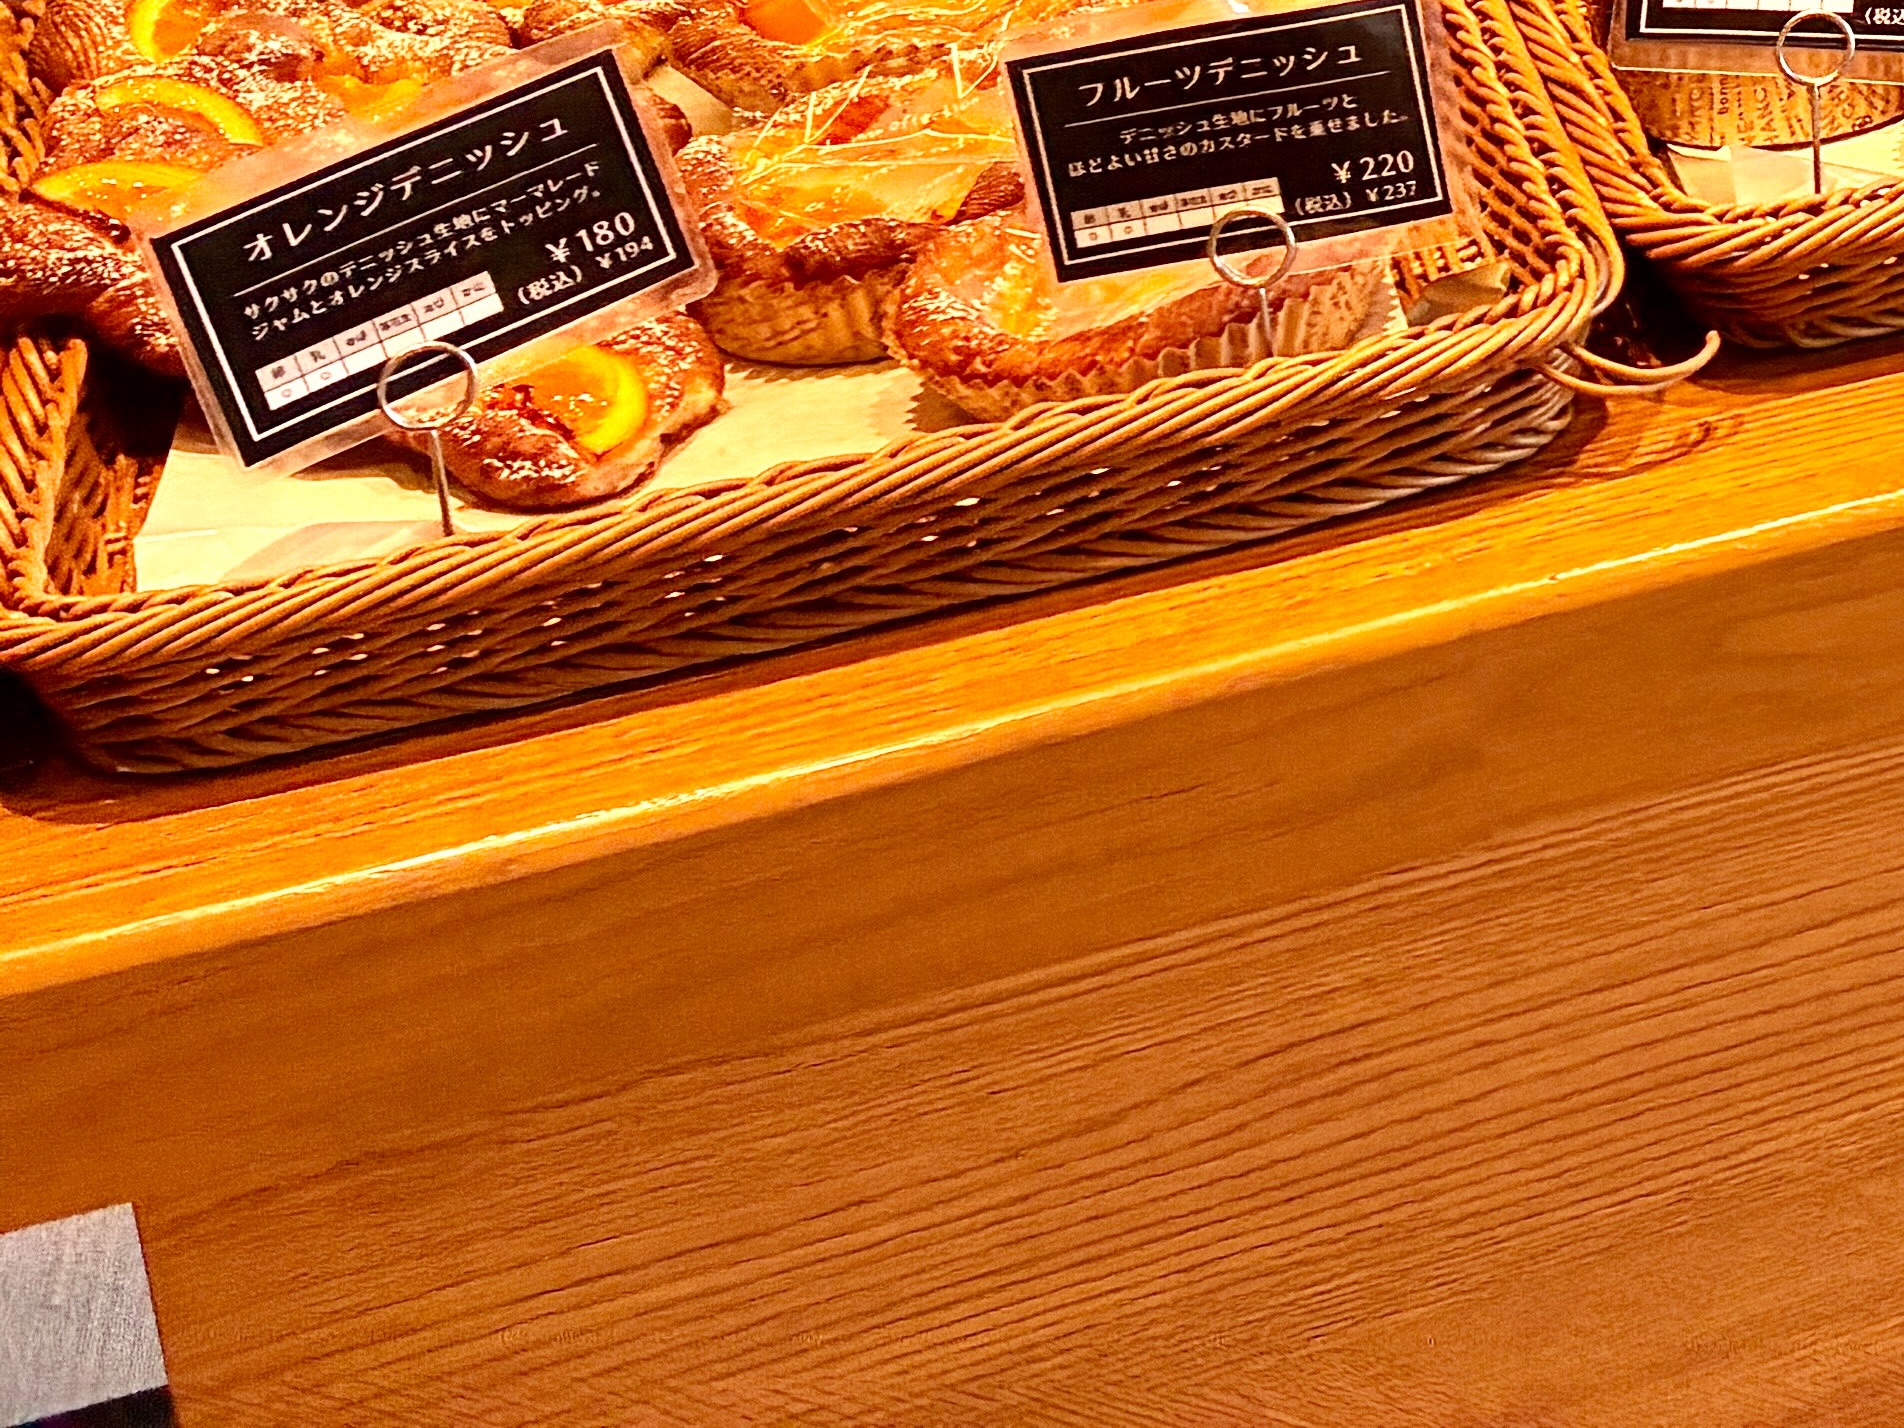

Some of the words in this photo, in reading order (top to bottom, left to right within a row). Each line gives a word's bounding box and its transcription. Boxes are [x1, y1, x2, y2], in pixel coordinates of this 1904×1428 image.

[1077, 43, 1363, 109] フルーツデニッシュ
[1118, 92, 1360, 145] デニッシュ生地にフルーツと
[242, 116, 570, 263] オレンジデニッシュ
[1331, 149, 1415, 185] ¥220
[1364, 180, 1418, 204] ¥237
[243, 159, 601, 320] サクサクのデニッシュ生地にマーマレード
[544, 211, 637, 263] ¥180
[597, 235, 655, 270] ¥194
[250, 187, 602, 341] ジャムとオレンジスライスをトッピング。
